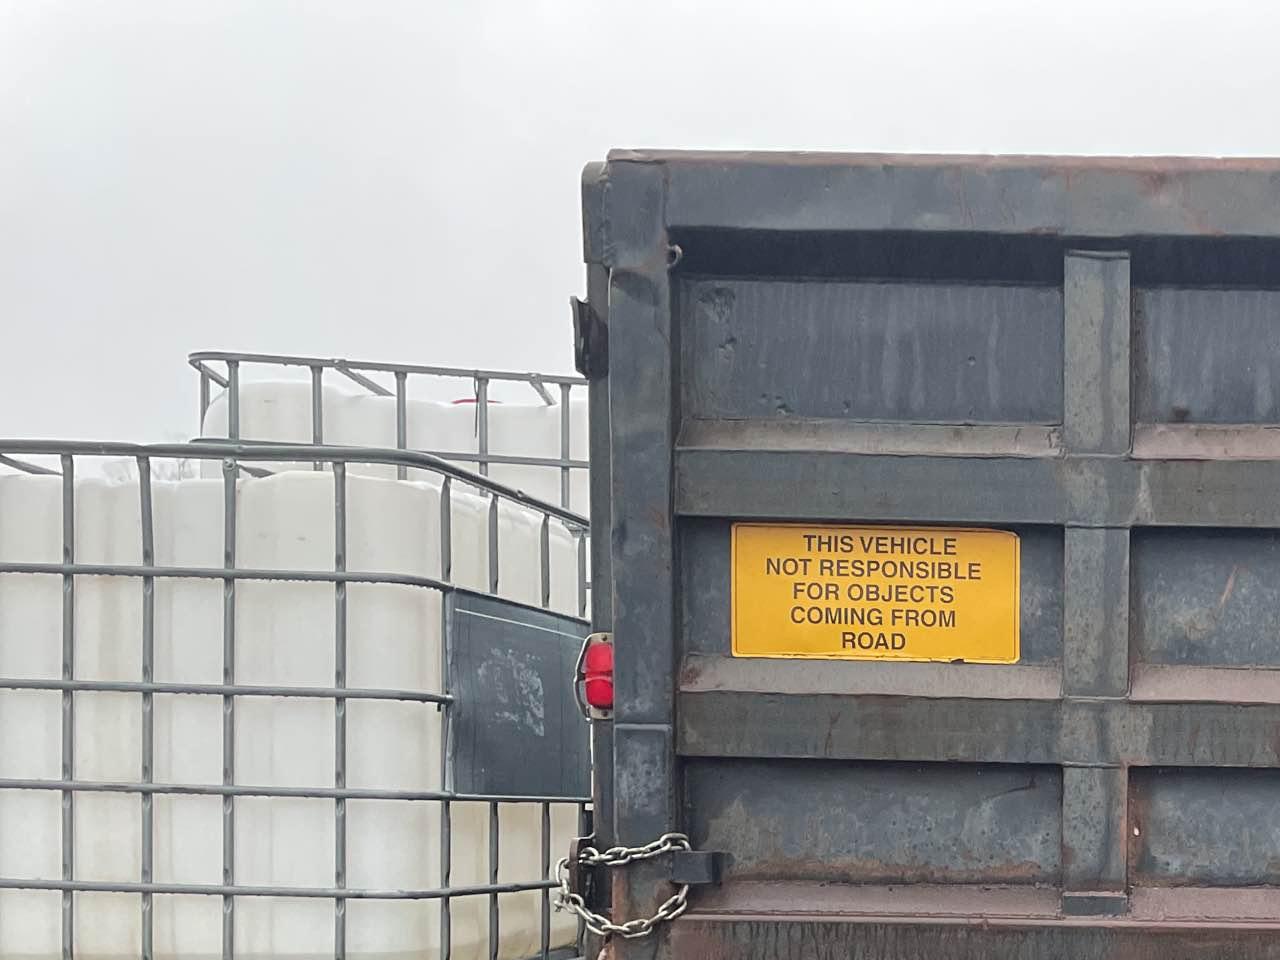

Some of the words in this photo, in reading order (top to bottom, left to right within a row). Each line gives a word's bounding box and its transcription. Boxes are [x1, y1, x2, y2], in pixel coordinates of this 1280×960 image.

[803, 535, 854, 553] THIS
[860, 536, 957, 556] VEHICLE
[766, 558, 812, 576] NOT
[820, 560, 981, 580] RESPONSIBLE
[793, 583, 840, 601] FOR
[848, 584, 954, 604] OBJECTS
[790, 606, 883, 626] COMING
[891, 609, 956, 628] FROM
[842, 632, 906, 650] ROAD
